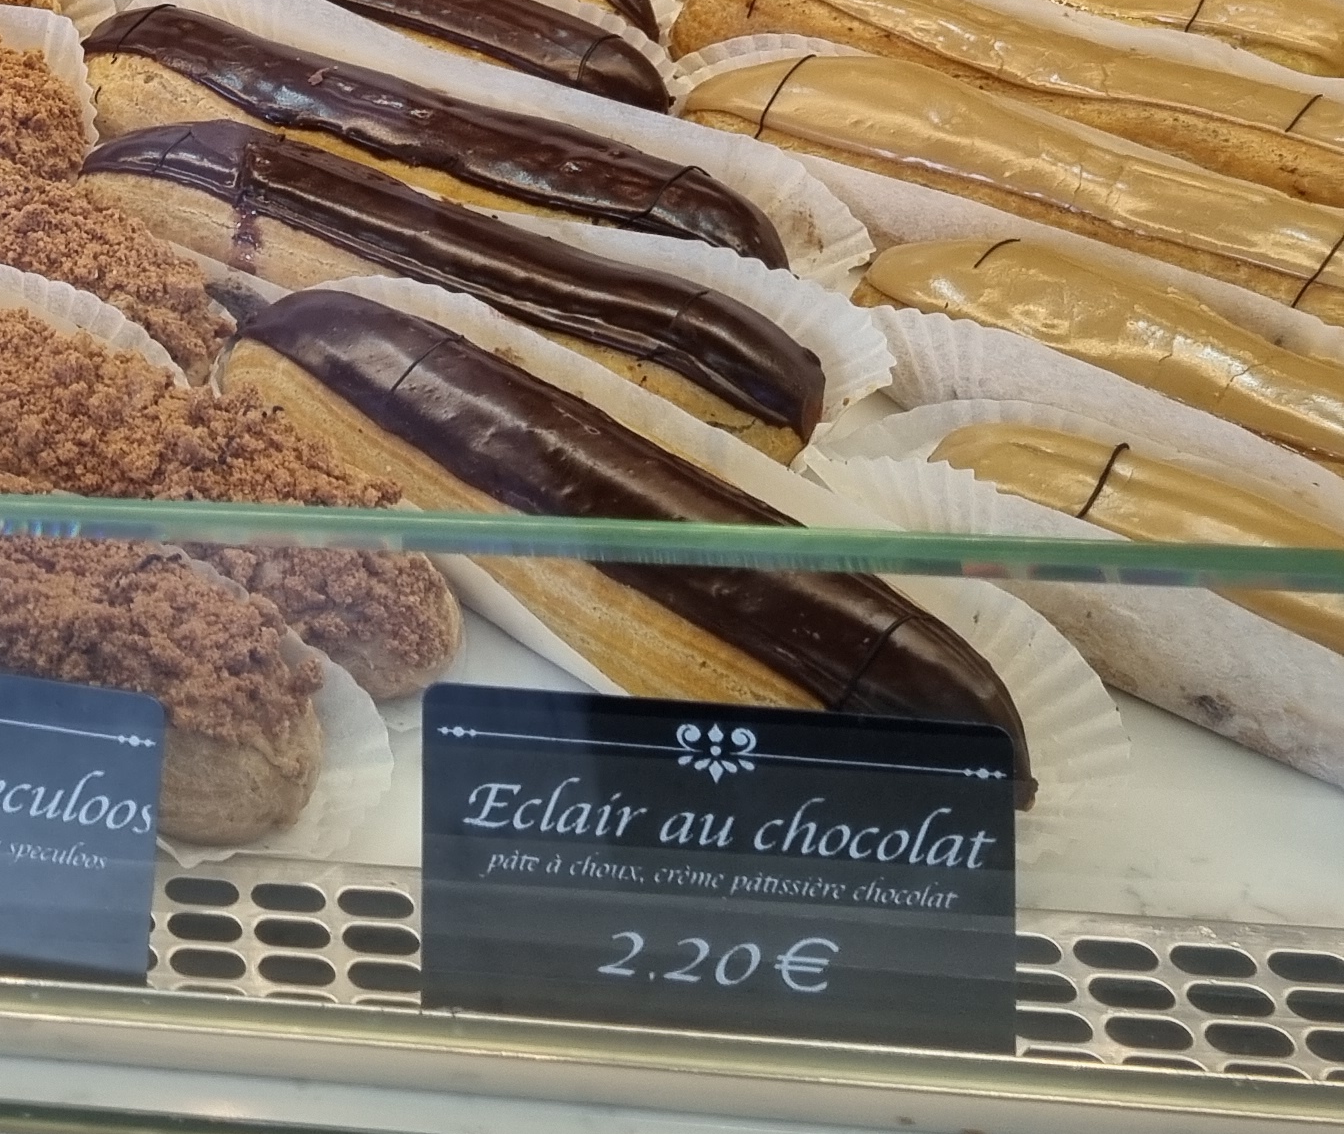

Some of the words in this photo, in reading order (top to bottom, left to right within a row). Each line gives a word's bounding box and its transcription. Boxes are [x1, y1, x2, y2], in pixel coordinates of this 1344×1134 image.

[462, 776, 648, 838] Eclair
[659, 812, 735, 848] au
[753, 797, 997, 869] chocolat
[10, 841, 108, 870] speculoos
[545, 853, 562, 874] à
[569, 851, 644, 884] choux,
[654, 864, 725, 889] crème
[852, 876, 959, 909] chocolat
[597, 931, 839, 992] 2.20€
